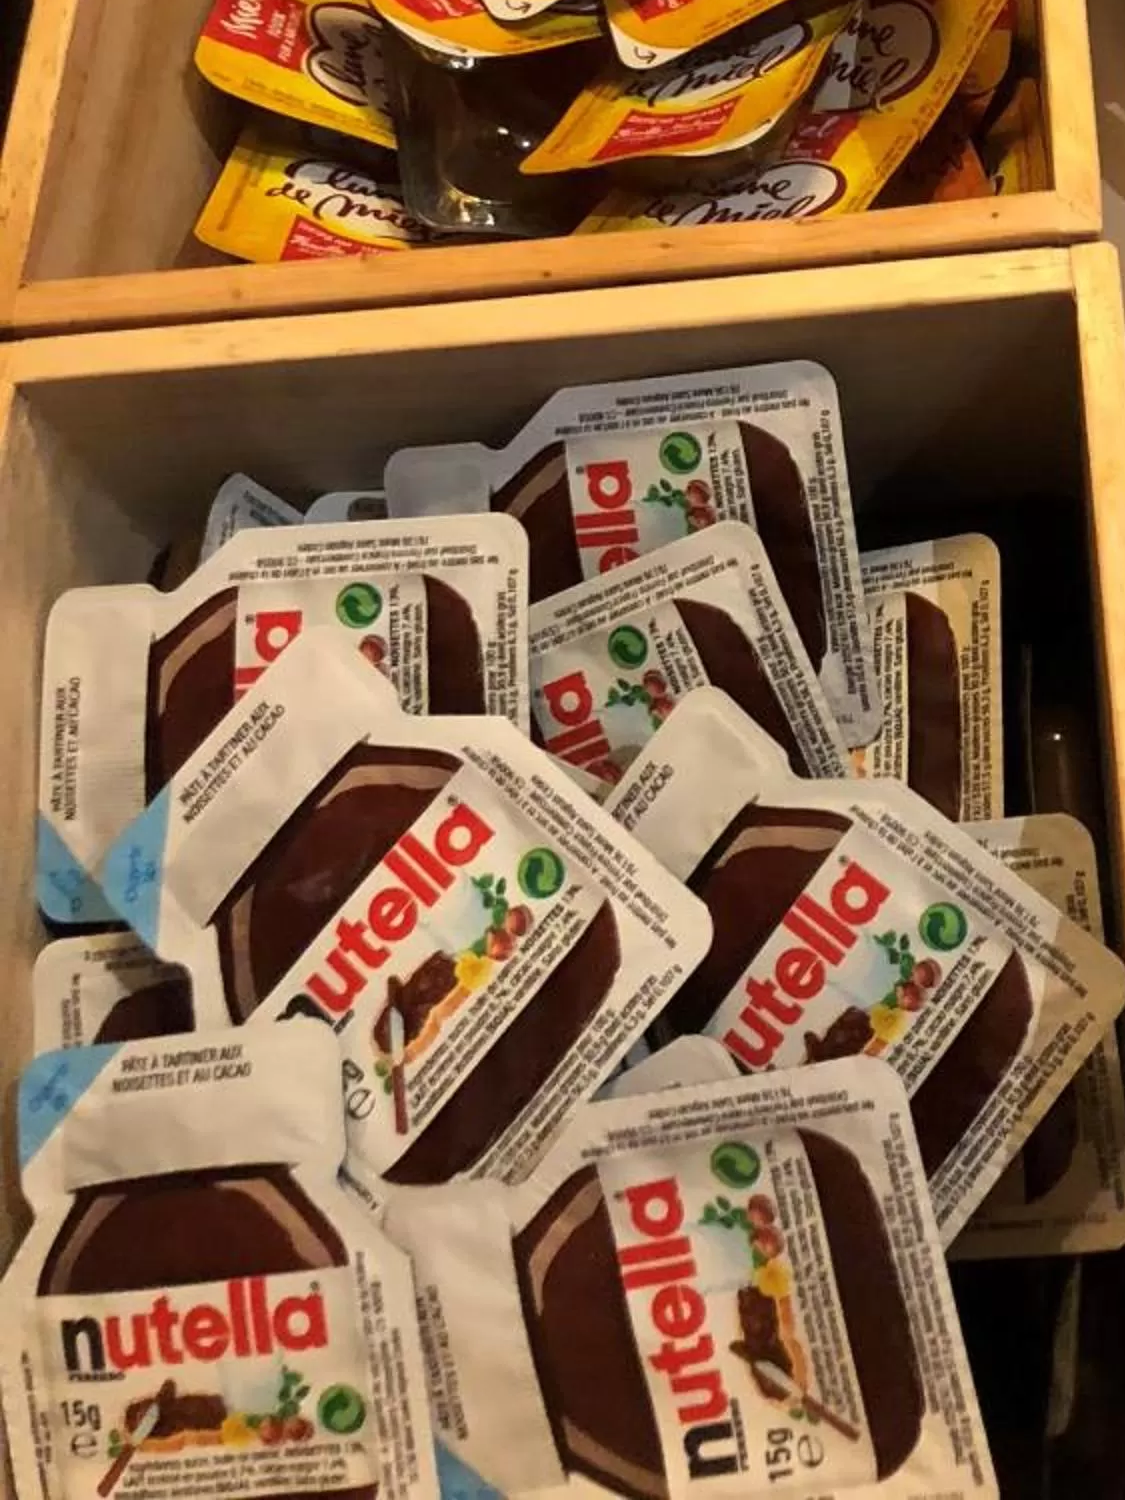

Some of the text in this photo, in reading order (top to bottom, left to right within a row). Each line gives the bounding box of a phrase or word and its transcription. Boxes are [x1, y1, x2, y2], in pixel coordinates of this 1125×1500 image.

[250, 701, 289, 742] CACAO
[640, 761, 676, 802] CACAO
[722, 861, 891, 1068] utella
[212, 1061, 252, 1080] CACAO
[61, 1276, 329, 1372] nutella
[617, 1176, 739, 1479] nutella
[62, 1400, 102, 1431] 15g
[767, 1428, 794, 1482] 15g
